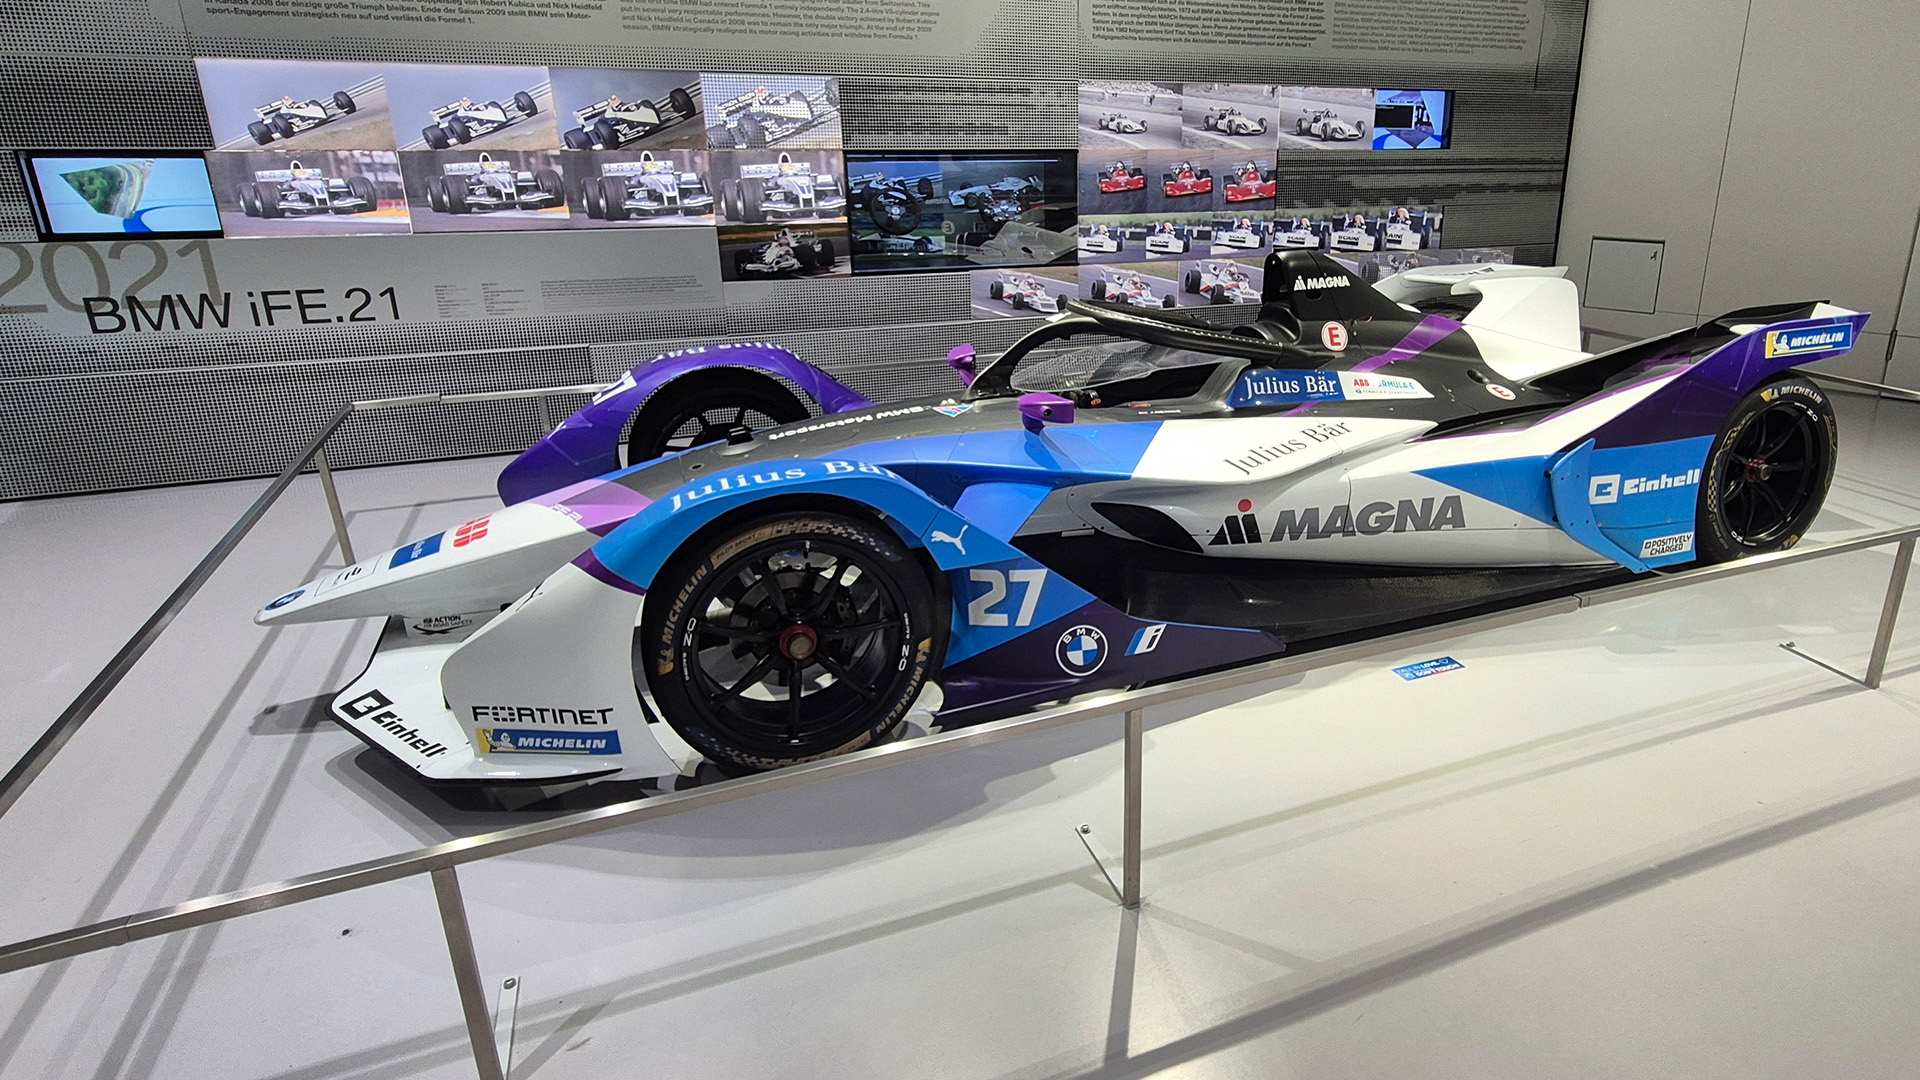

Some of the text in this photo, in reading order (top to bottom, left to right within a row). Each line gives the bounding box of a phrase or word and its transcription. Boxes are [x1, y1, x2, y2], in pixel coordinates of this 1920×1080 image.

[292, 0, 322, 9] einzige
[351, 3, 385, 12] Triumph
[508, 0, 535, 8] Kubica
[714, 0, 739, 8] entered
[291, 10, 339, 19] strategisch
[1307, 275, 1350, 290] MAGNA
[82, 292, 231, 334] BMW
[247, 286, 401, 327] iFE.21
[1328, 327, 1341, 347] E
[1790, 332, 1844, 347] MICHELIN
[1246, 371, 1337, 399] Julius Bär
[1354, 378, 1370, 388] ABB
[1781, 385, 1822, 405] MICHELIN
[768, 406, 924, 441] BMW Motorsport
[1223, 420, 1352, 476] Julius Bär
[670, 458, 900, 514] Julius Bär
[1623, 469, 1700, 495] Einhell
[1269, 495, 1466, 543] MAGNA
[716, 533, 756, 560] PILOT SPORT
[1650, 544, 1684, 556] CHARGED
[1652, 534, 1692, 549] POSITIVELY
[662, 565, 708, 646] MICHELIN
[968, 568, 1048, 627] 27
[434, 614, 461, 624] ACTION
[450, 618, 473, 626] SAFETY
[876, 666, 924, 733] MICHELIN
[471, 705, 614, 726] FORTINET
[371, 706, 448, 759] Einhell
[517, 736, 607, 750] MICHELIN
